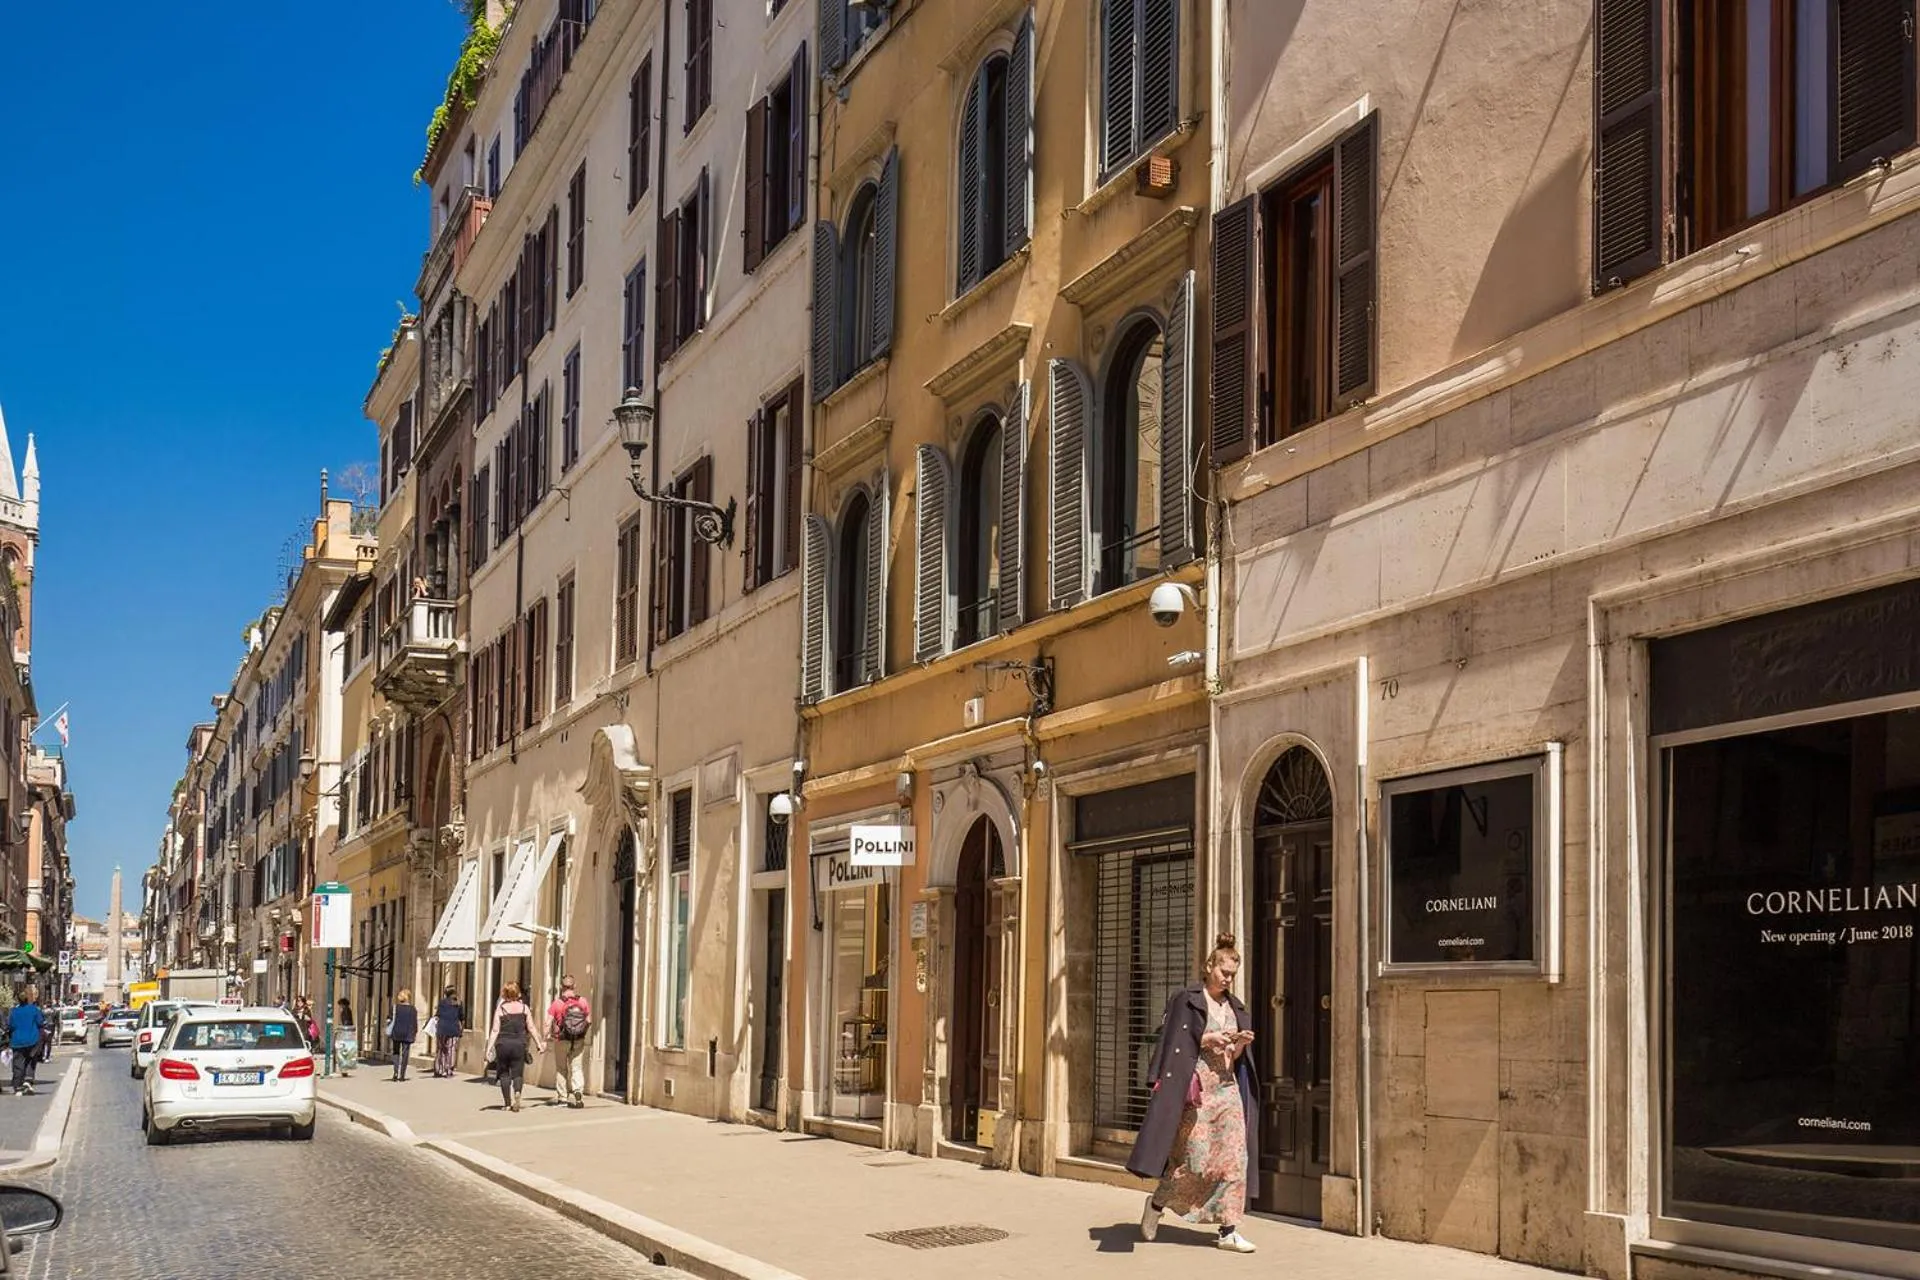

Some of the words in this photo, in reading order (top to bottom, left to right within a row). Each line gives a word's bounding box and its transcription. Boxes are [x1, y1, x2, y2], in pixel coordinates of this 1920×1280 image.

[1380, 679, 1399, 700] 70
[855, 838, 913, 855] POLLINI
[829, 856, 873, 886] POLLINI
[1425, 896, 1497, 913] CORNELIANI
[1746, 883, 1917, 915] CORNELIAN
[1438, 936, 1485, 947] corneliani.com
[1761, 929, 1787, 943] New
[1789, 929, 1836, 946] opening
[1839, 927, 1846, 941] /
[1847, 927, 1879, 944] June
[1882, 925, 1913, 939] 2018
[1797, 1117, 1871, 1131] corneliani.com
